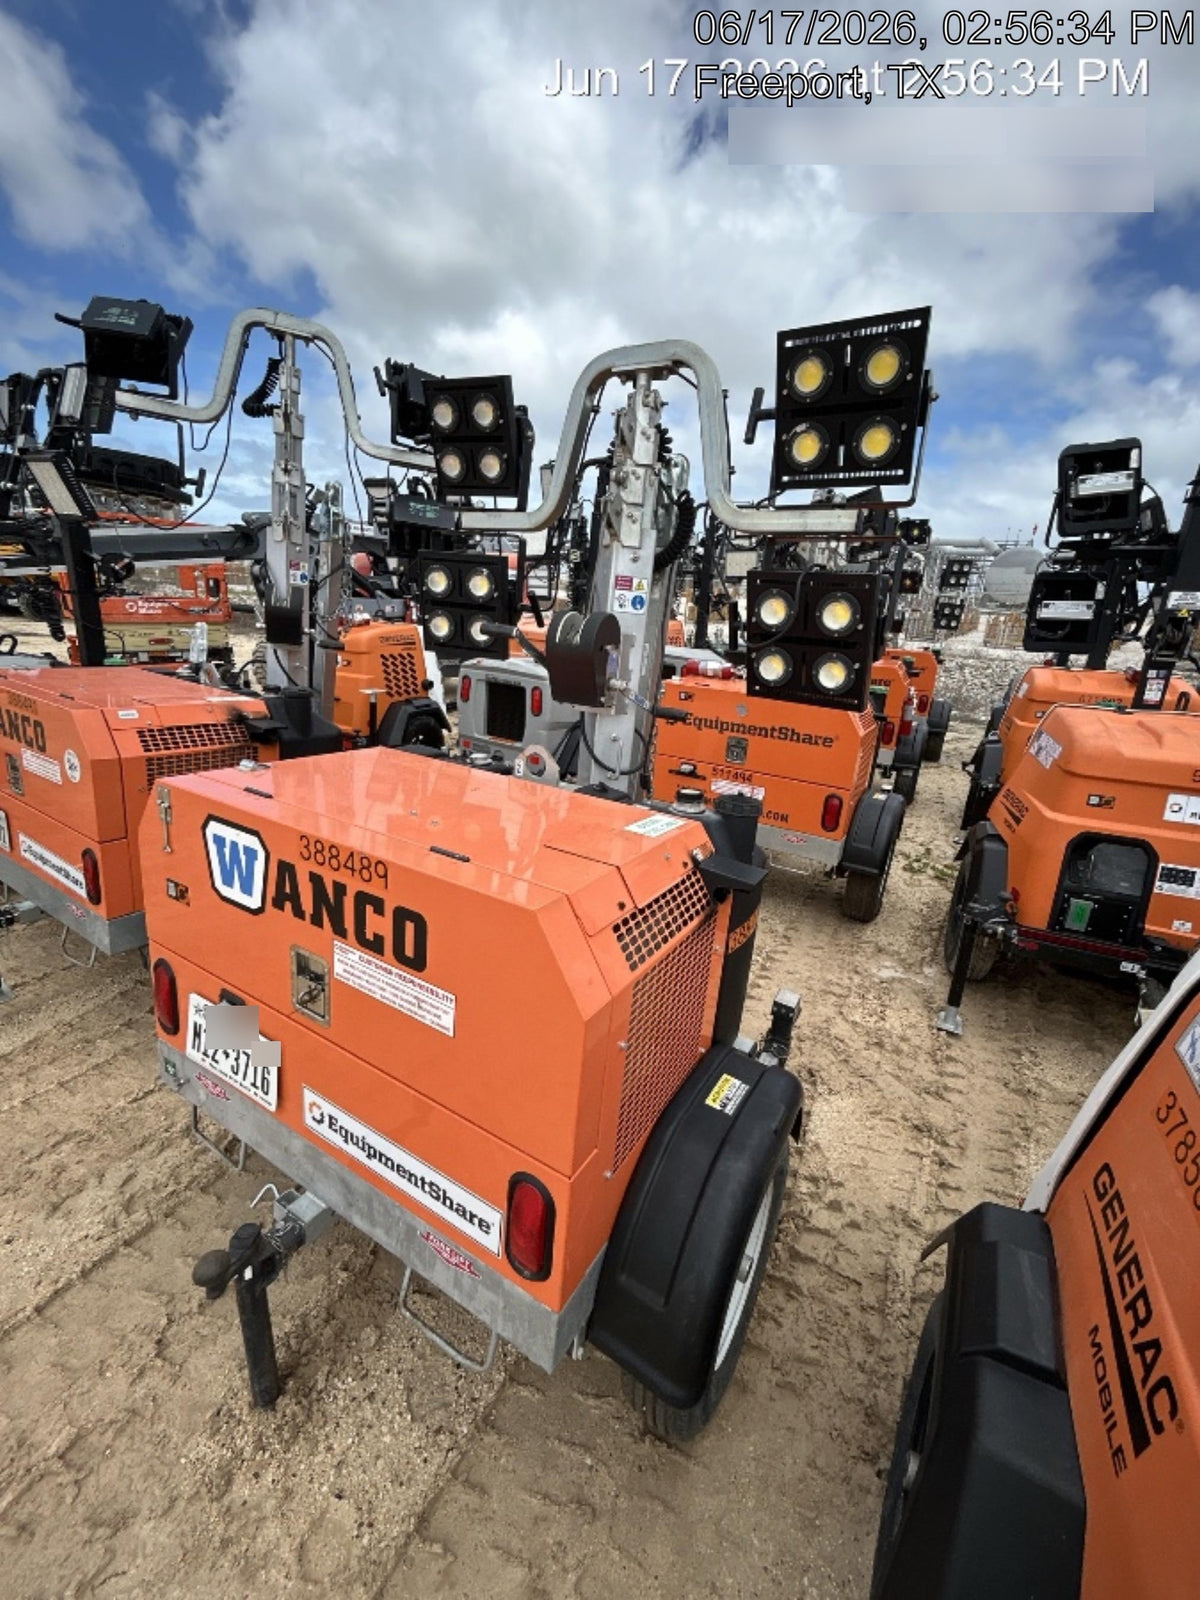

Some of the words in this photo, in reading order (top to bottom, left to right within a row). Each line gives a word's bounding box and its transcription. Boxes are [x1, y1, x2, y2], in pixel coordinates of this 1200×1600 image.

[300, 835, 389, 890] 388489
[327, 1114, 492, 1236] EquipmentShare
[1093, 1162, 1178, 1436] GENERAC
[1088, 1324, 1128, 1479] MOBILE
